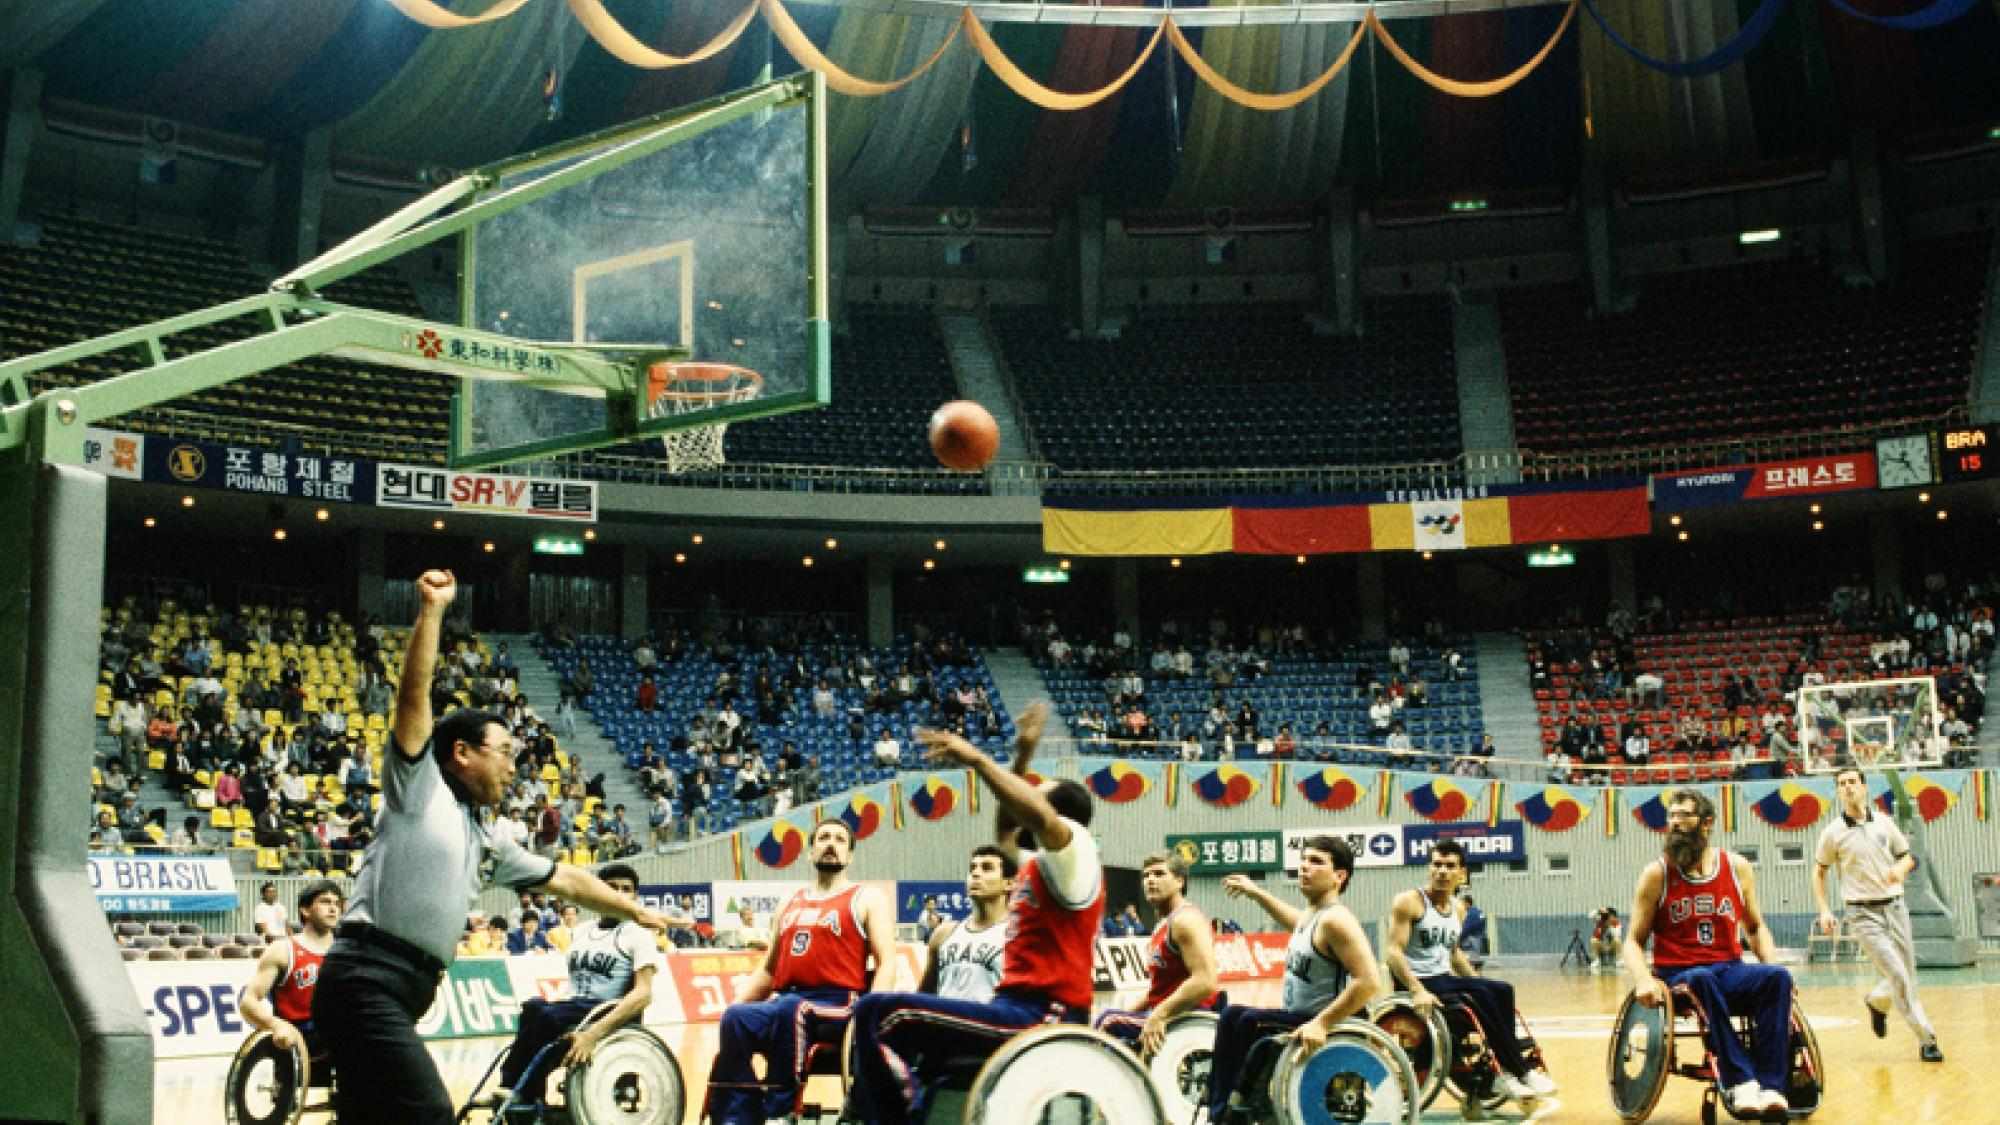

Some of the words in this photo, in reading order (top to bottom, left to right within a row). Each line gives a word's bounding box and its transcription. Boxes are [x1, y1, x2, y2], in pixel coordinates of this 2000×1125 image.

[1945, 431, 1985, 449] BRA
[225, 472, 288, 495] POHANG
[302, 481, 352, 500] STEEL
[1765, 462, 1857, 490] 프레스토
[451, 475, 527, 507] SR-V
[114, 861, 218, 890] BRASIL
[1669, 892, 1736, 923] USA
[790, 930, 811, 956] 9
[144, 984, 252, 1037] -SPE
